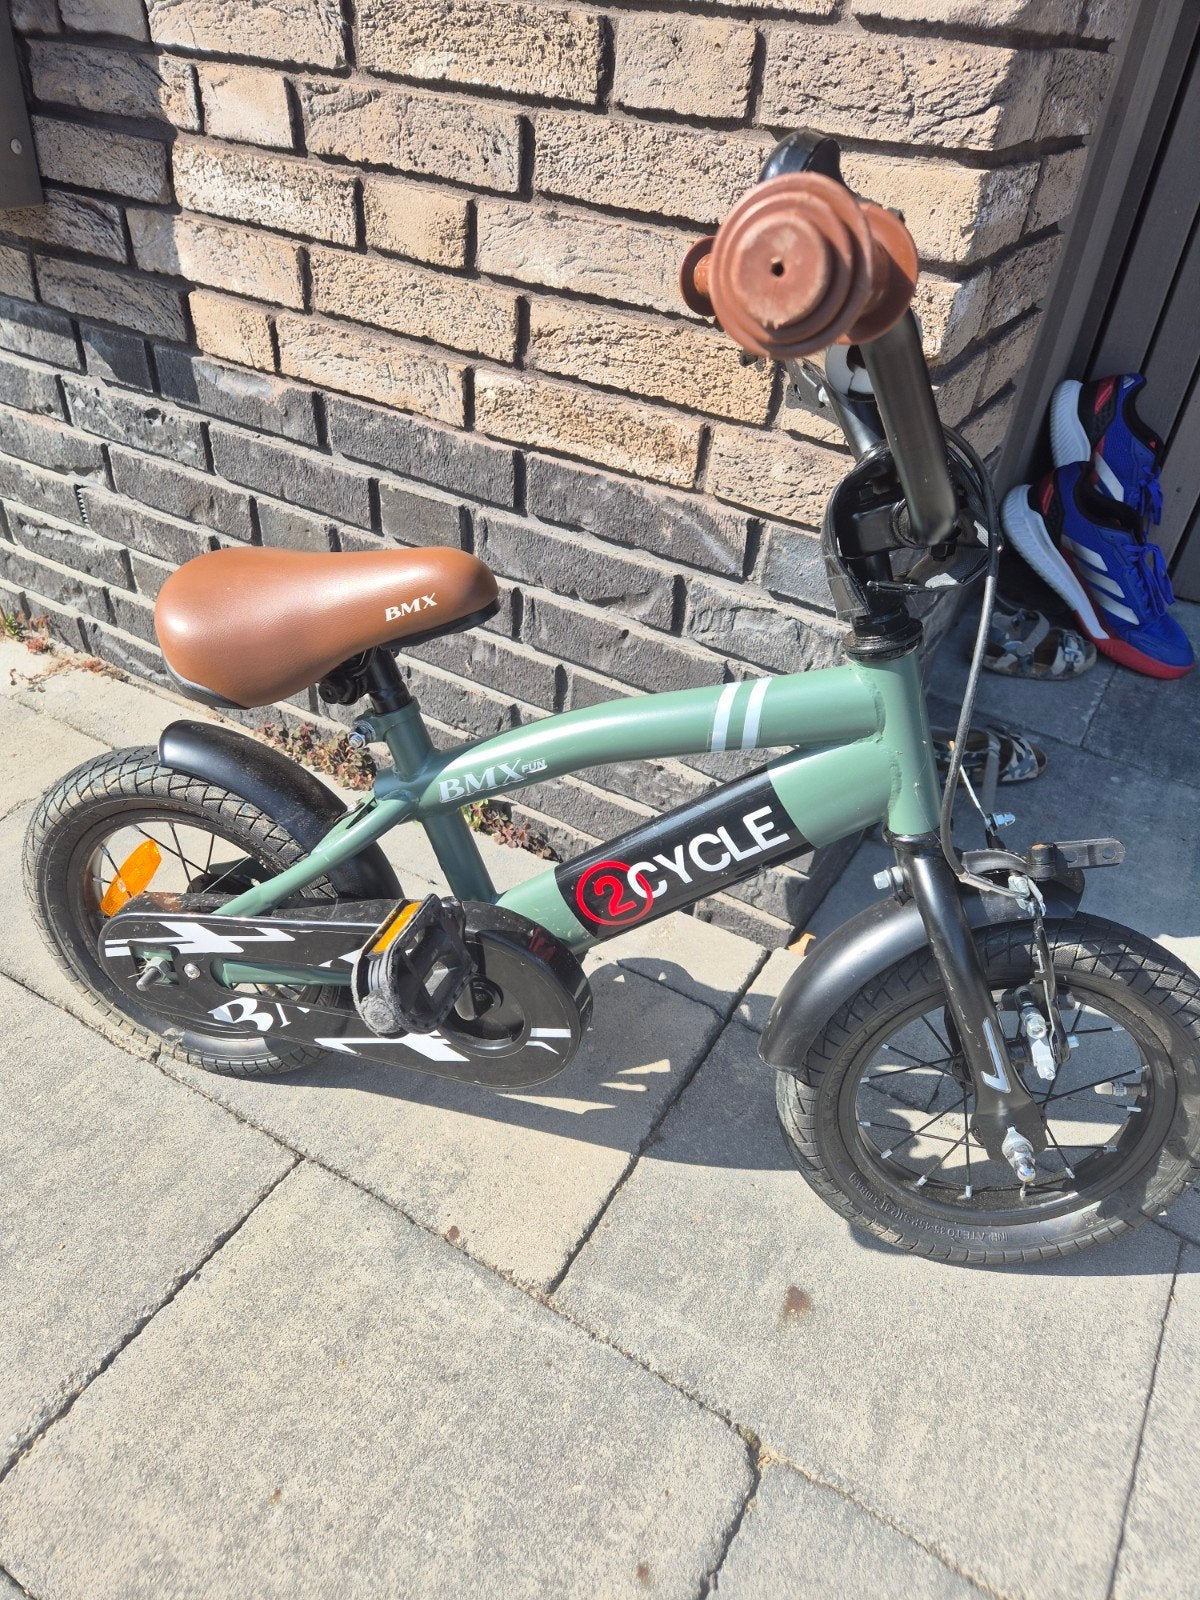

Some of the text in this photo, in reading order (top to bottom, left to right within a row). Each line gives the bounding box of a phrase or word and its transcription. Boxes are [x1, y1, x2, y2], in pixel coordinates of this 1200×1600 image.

[385, 592, 438, 622] BMX
[438, 757, 546, 804] BMX FUN
